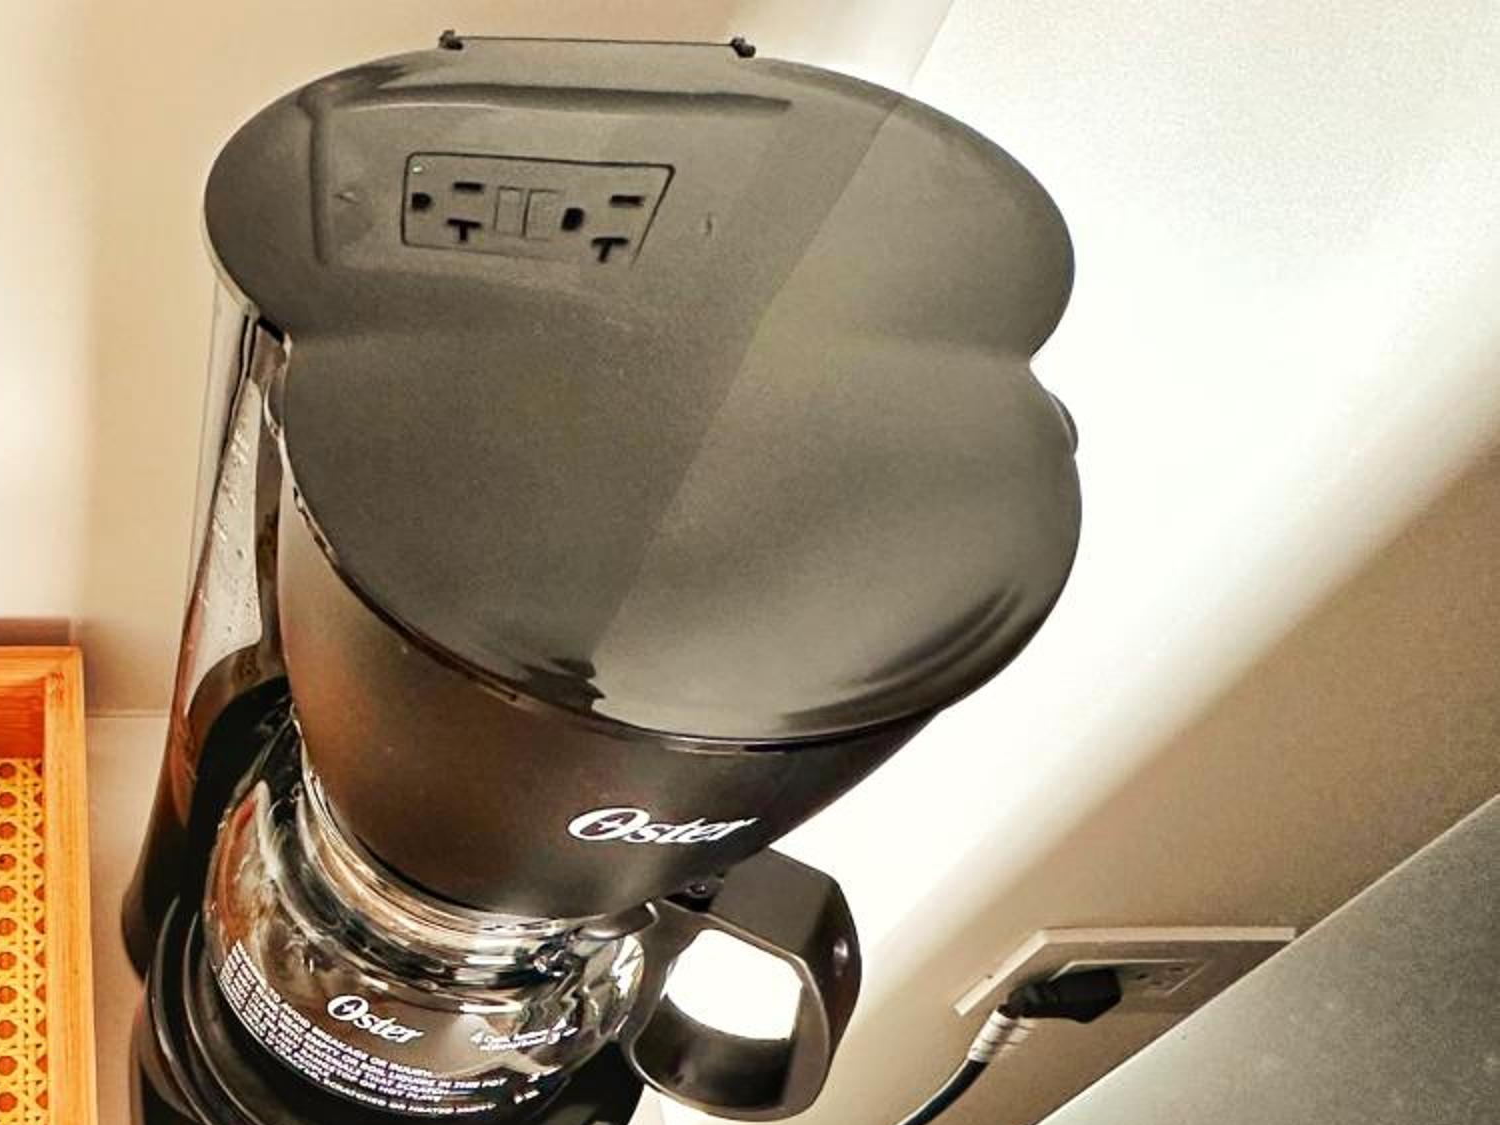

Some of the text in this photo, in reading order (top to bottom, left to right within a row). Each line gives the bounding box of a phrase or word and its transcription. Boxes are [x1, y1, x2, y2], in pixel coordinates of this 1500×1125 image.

[567, 807, 760, 844] Oster
[278, 998, 312, 1029] AVOID
[310, 1024, 369, 1061] BREAKAGE
[367, 1055, 389, 1068] OR
[328, 995, 424, 1042] Oster
[303, 1030, 342, 1058] EMPTY
[340, 1052, 359, 1067] OR
[358, 1078, 377, 1090] OR
[378, 1083, 406, 1097] HOT
